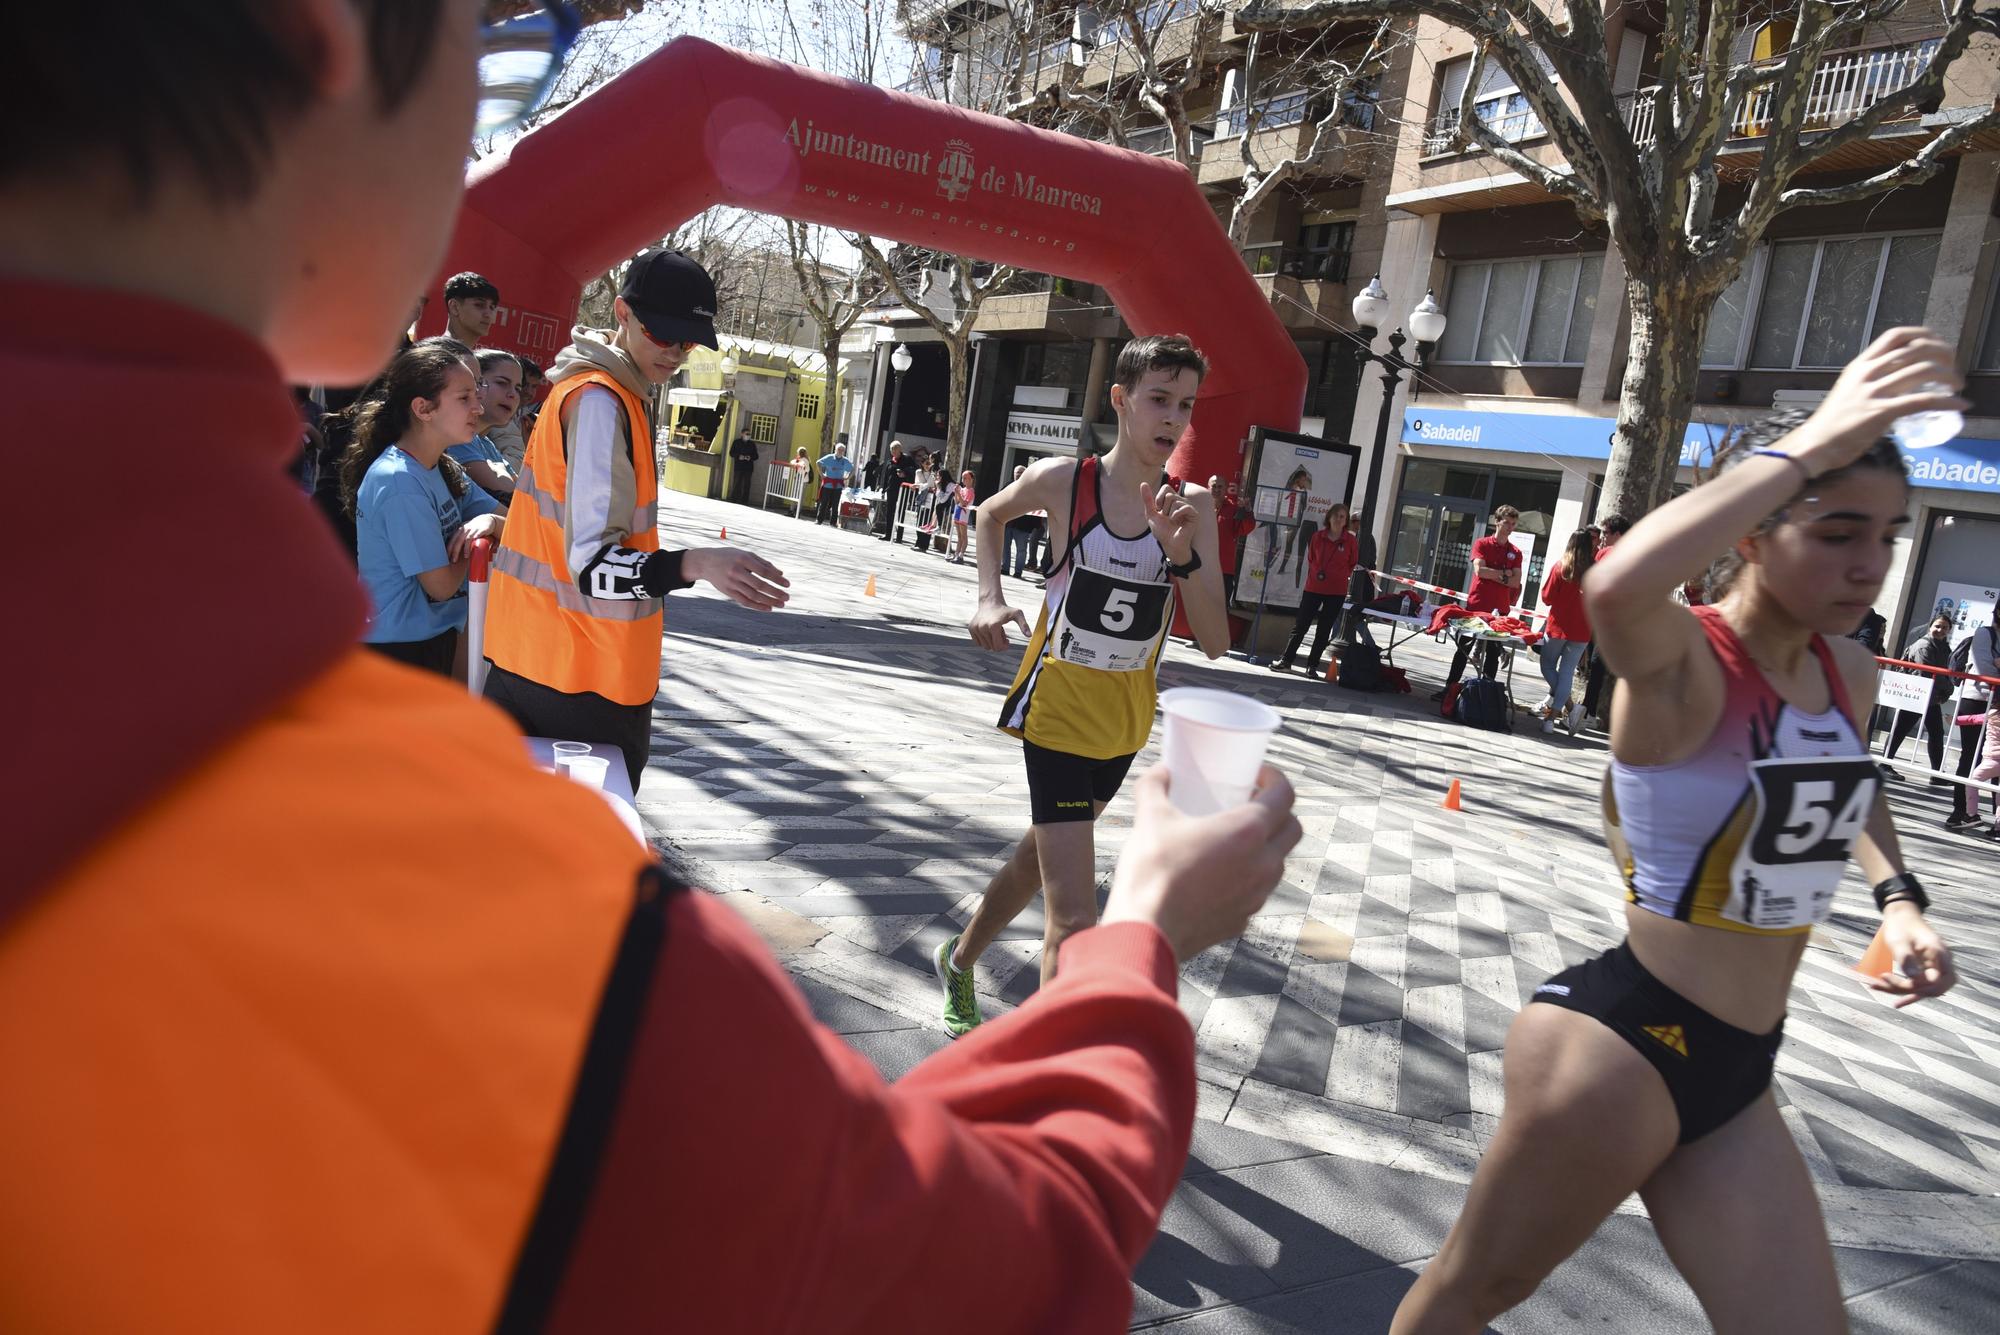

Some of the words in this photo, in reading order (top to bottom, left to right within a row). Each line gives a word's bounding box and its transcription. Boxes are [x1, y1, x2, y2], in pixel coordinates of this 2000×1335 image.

[782, 117, 932, 175] Ajuntament
[980, 166, 1006, 193] de
[1011, 172, 1102, 216] Manresa
[805, 184, 1076, 252] www.ajmanresa.org
[1008, 421, 1033, 435] SEVEN
[1421, 422, 1481, 443] Sabadell
[1903, 455, 2000, 485] Sabade
[1100, 587, 1138, 632] 5
[1775, 778, 1877, 854] 54
